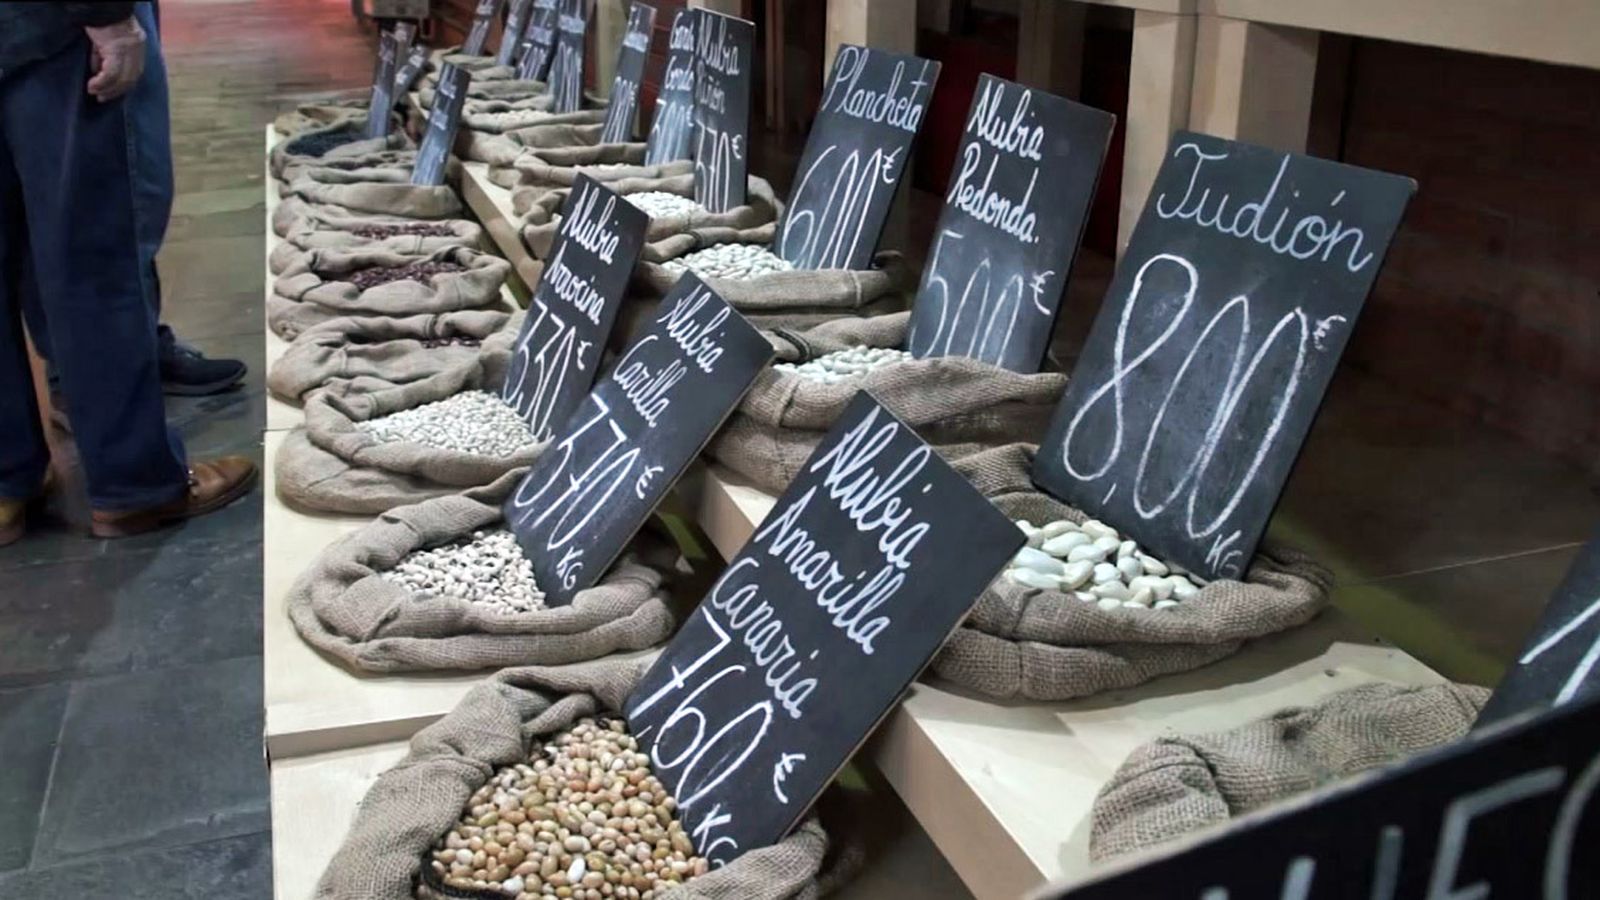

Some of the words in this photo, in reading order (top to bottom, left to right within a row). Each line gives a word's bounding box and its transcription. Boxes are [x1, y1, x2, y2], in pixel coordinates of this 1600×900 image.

[696, 12, 739, 75] Alubia
[966, 79, 1044, 161] Alubia
[561, 181, 619, 265] Alubia
[1157, 142, 1374, 273] Judión
[656, 283, 732, 374] Alubia
[612, 334, 688, 428] Carilla
[811, 405, 932, 567] Alubia
[754, 485, 906, 654] Amarilla
[711, 557, 818, 719] Canaria
